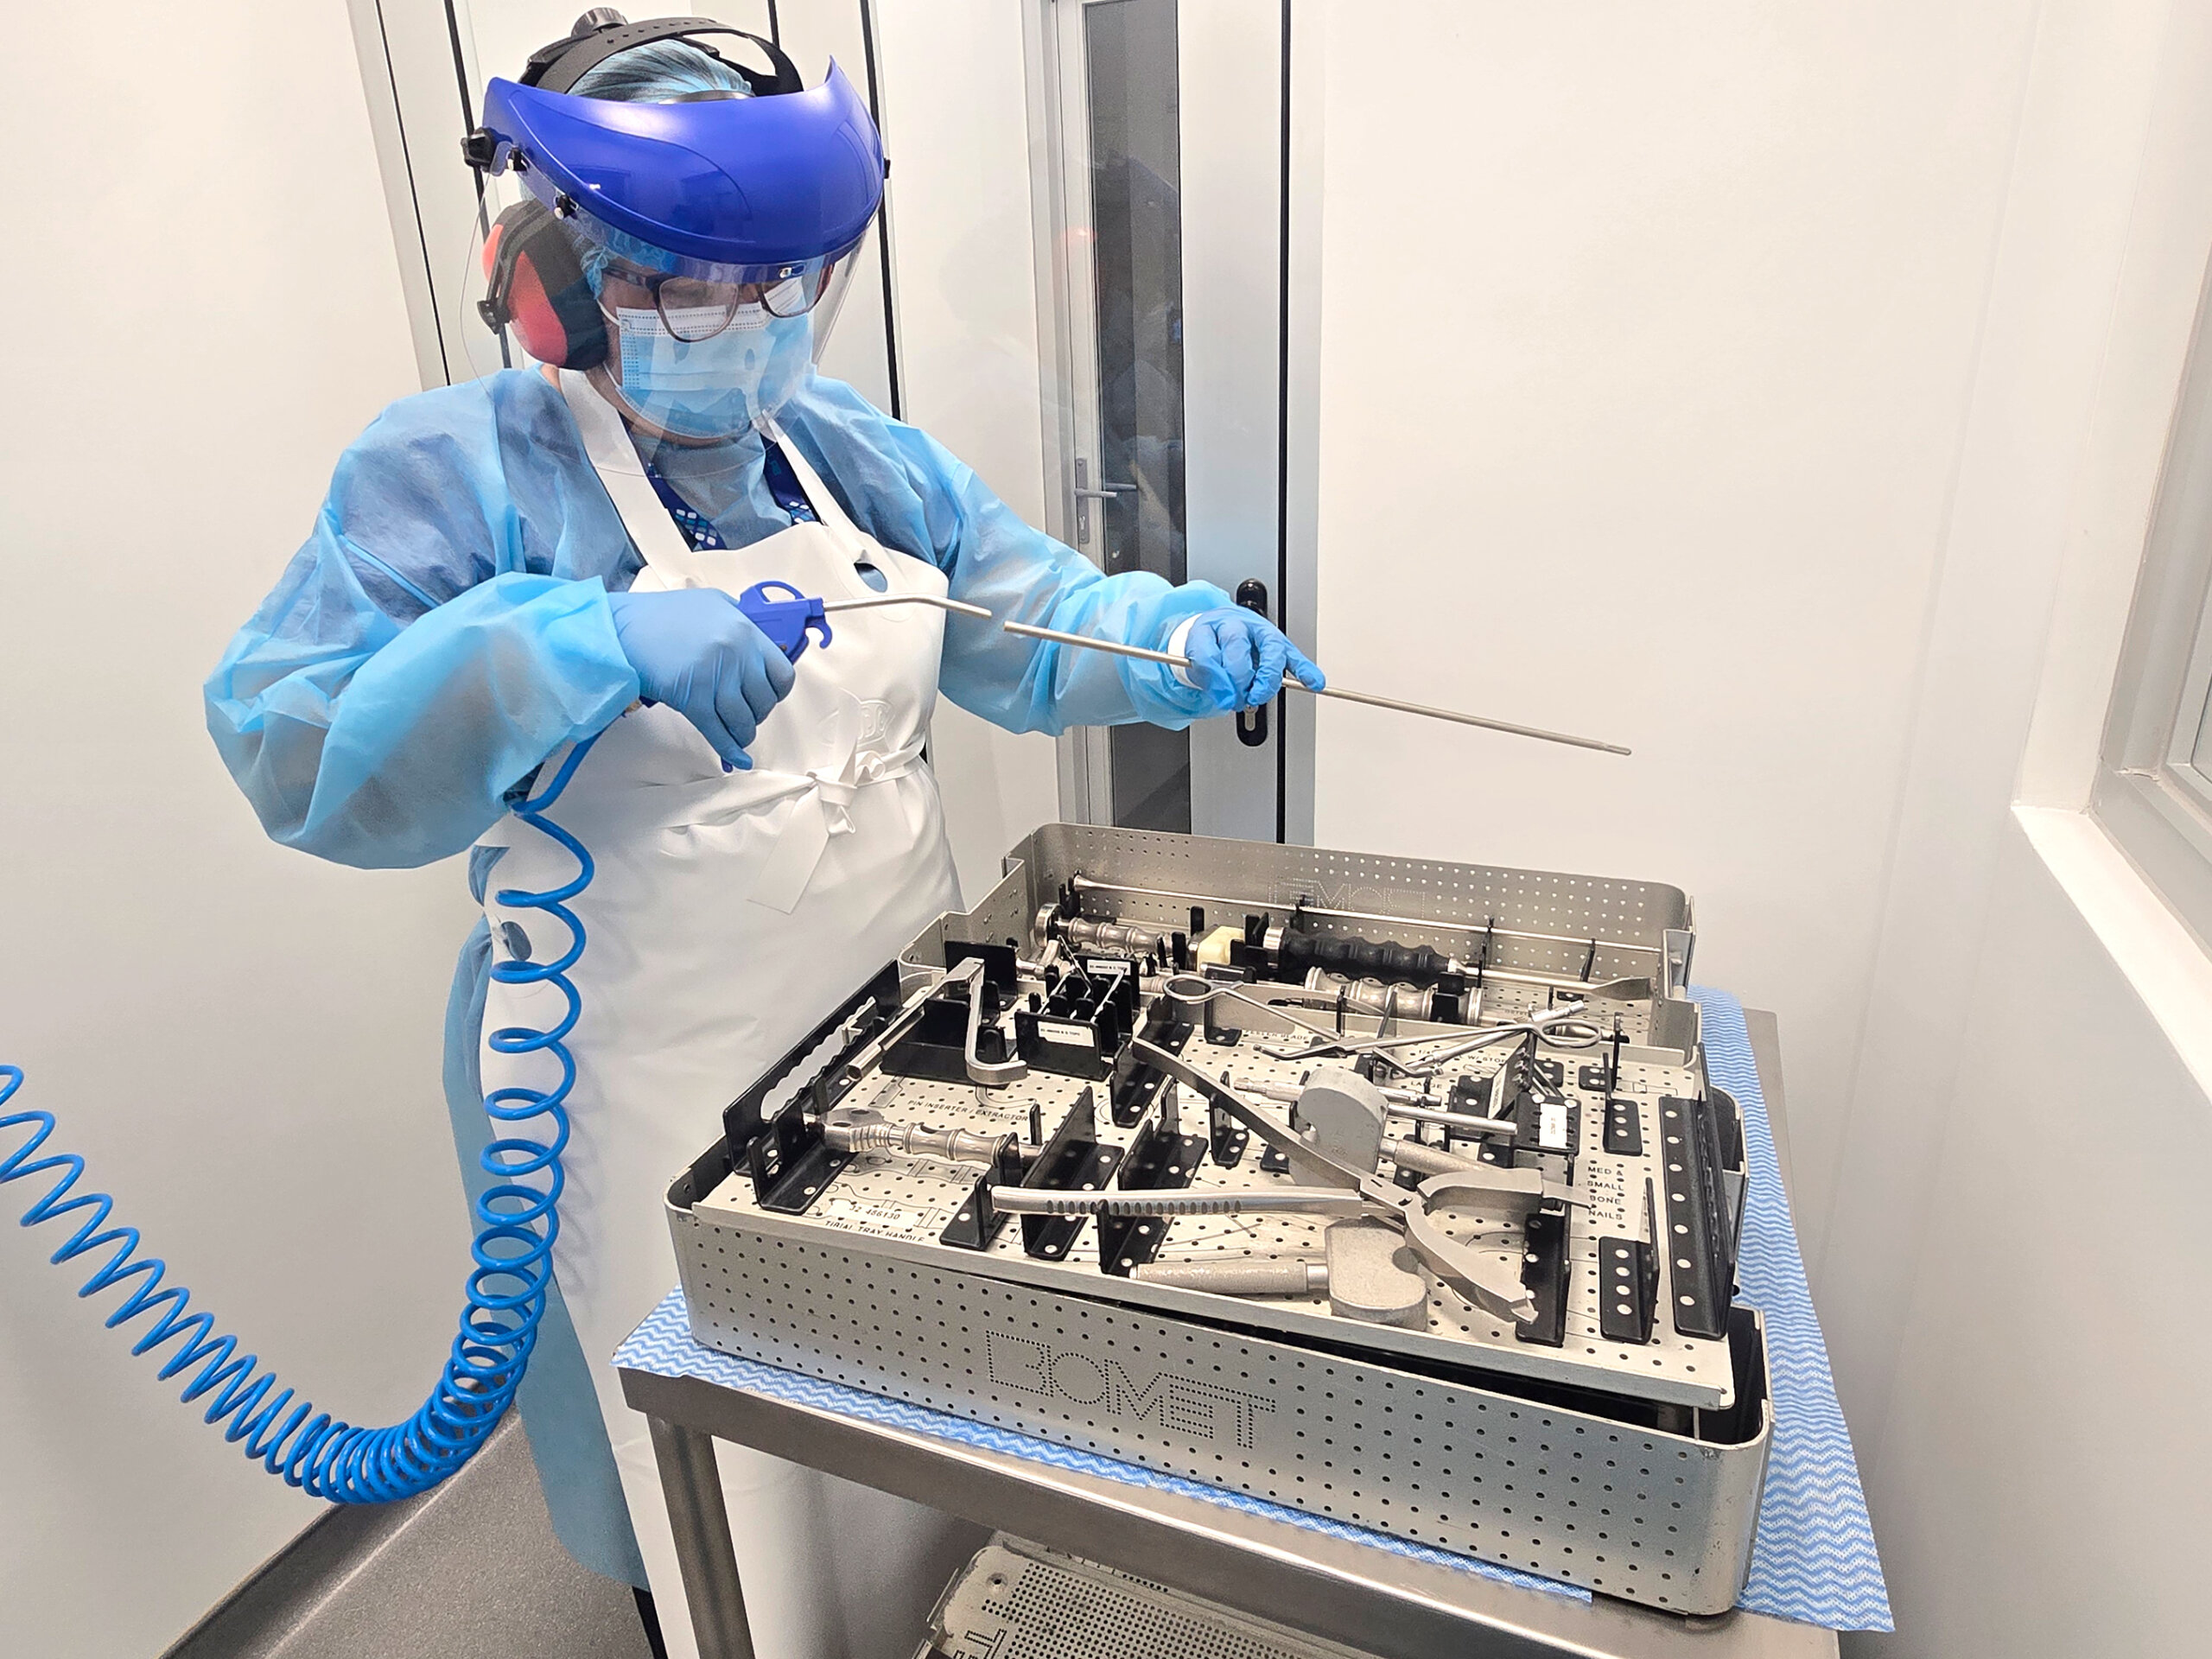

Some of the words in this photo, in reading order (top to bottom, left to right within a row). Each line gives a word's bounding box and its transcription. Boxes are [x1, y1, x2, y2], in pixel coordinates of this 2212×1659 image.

[925, 1102, 969, 1113] INSERTER
[976, 1108, 1029, 1122] EXTRACTOR
[1588, 1166, 1612, 1175] MED
[1587, 1180, 1624, 1192] SMALL
[1590, 1195, 1622, 1205] BONE
[1588, 1210, 1623, 1220] NAILS
[858, 1226, 884, 1236] TRAY
[985, 1329, 1277, 1450] BIOMET
